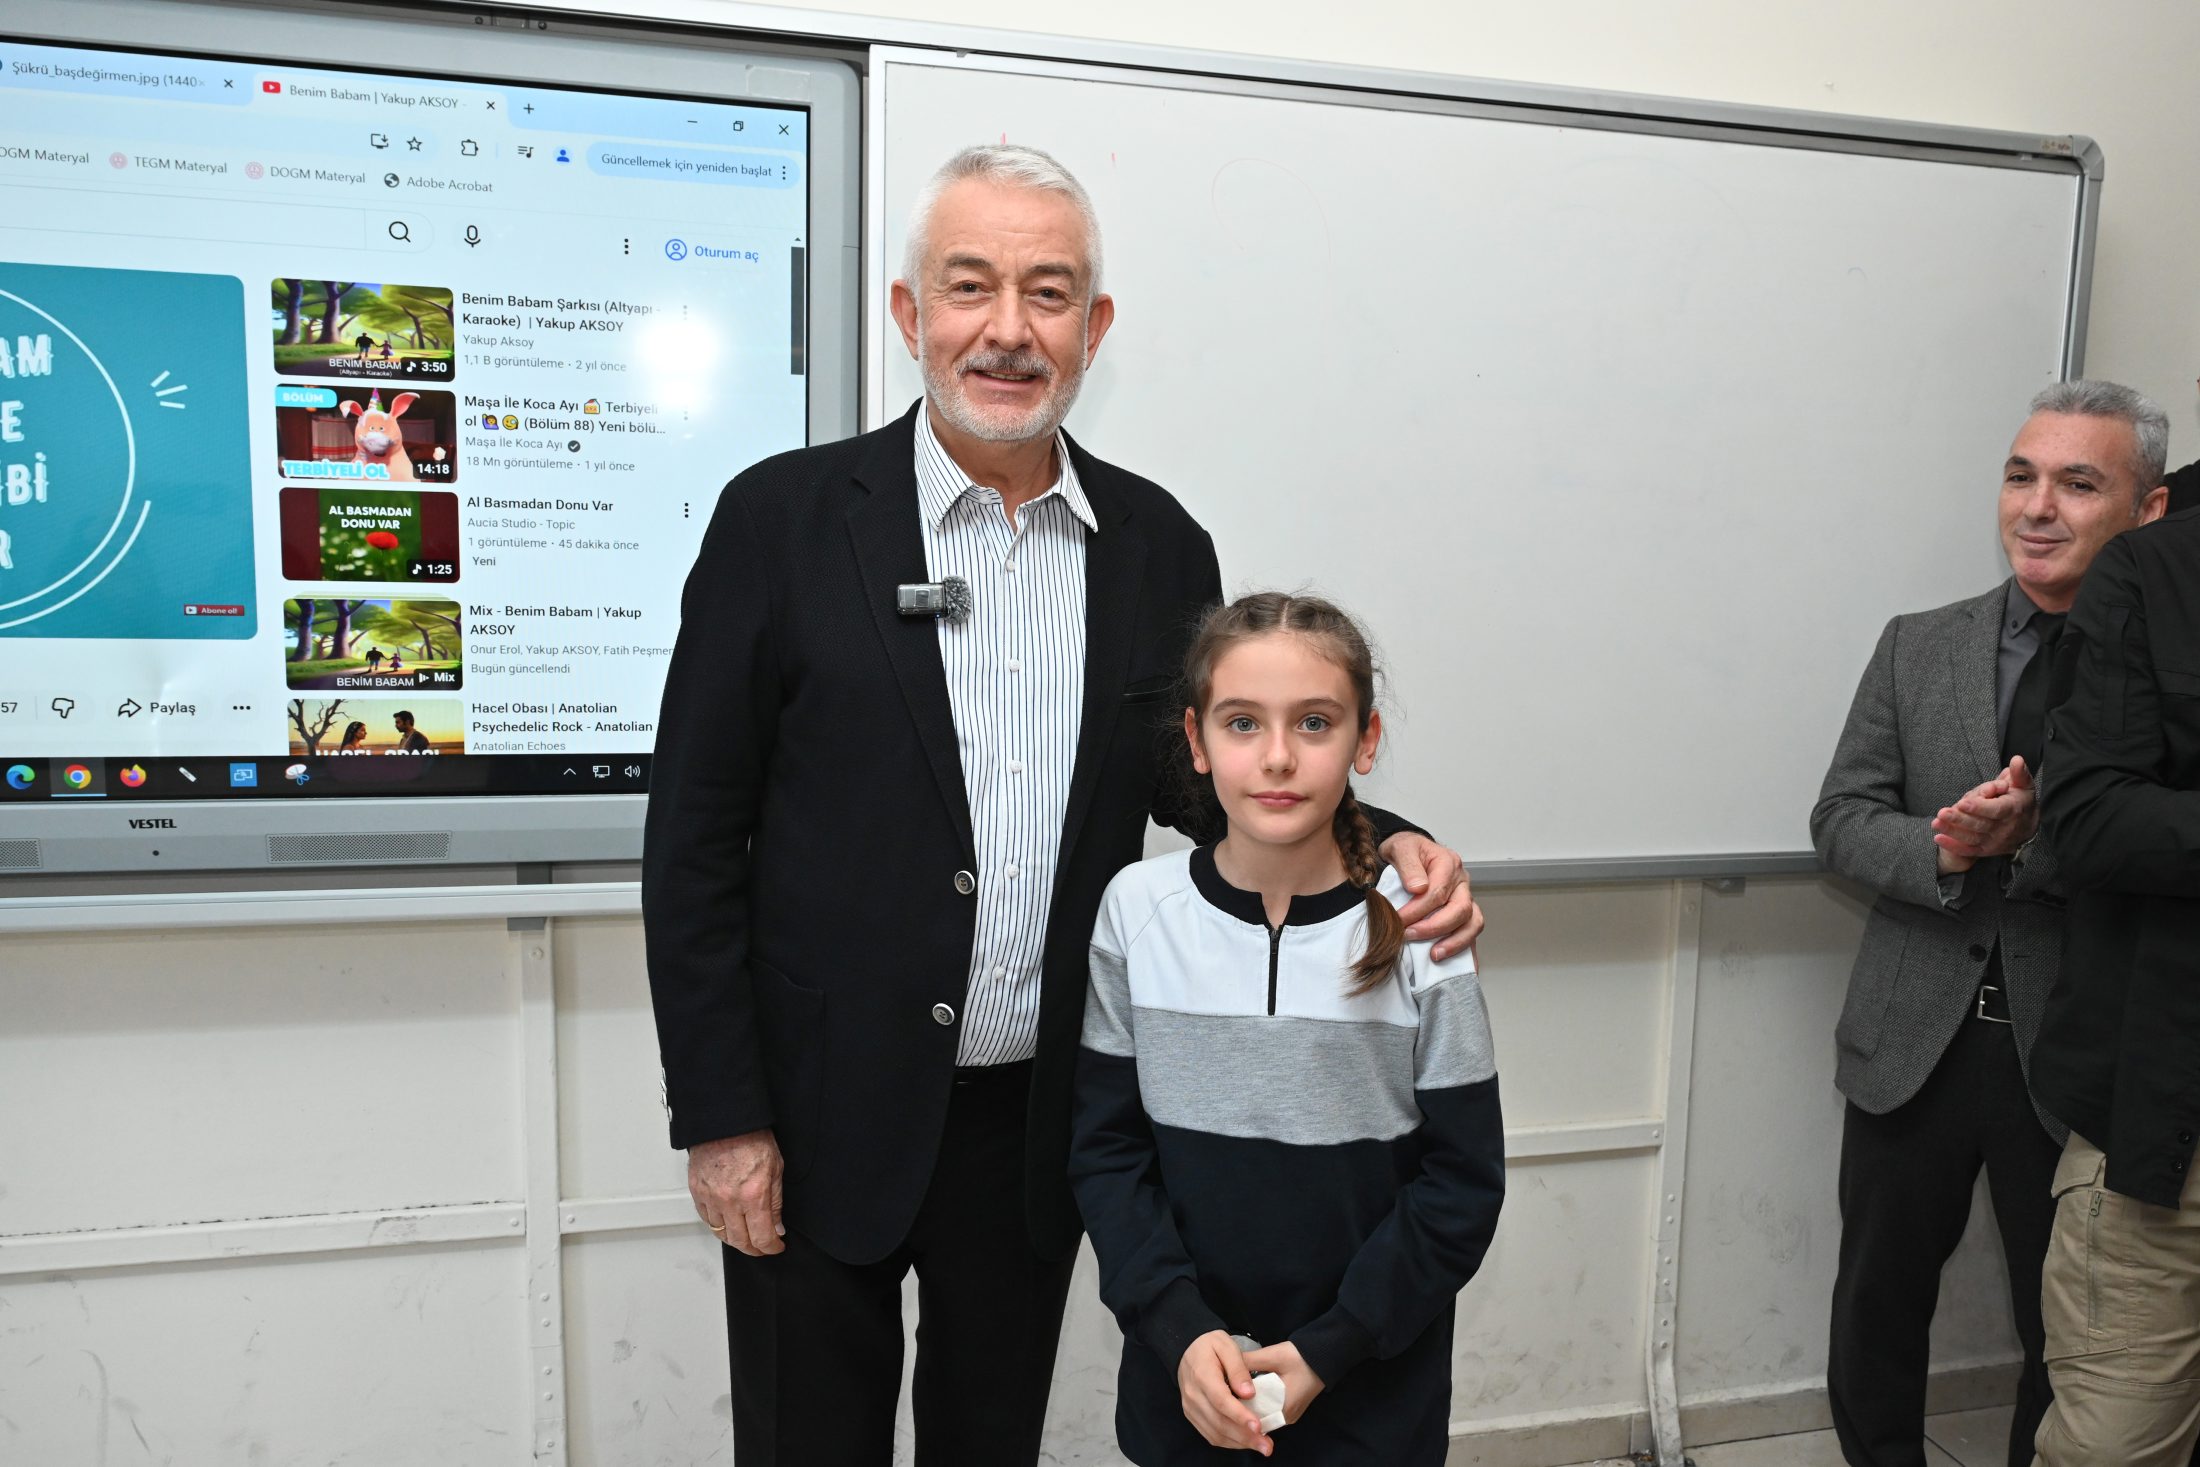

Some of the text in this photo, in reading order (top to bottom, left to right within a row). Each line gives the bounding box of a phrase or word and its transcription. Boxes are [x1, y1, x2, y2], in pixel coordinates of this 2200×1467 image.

[12, 61, 159, 87] Şükrü_başdeğirmen.jpg
[290, 85, 327, 98] Benim
[330, 88, 371, 102] Babam
[381, 93, 415, 107] Yakup
[419, 95, 458, 108] AKSOY
[35, 149, 89, 165] Materyal
[134, 156, 227, 176] TEGM Materyal
[601, 153, 772, 179] Güncellemek için yeniden başlat
[270, 167, 365, 186] DOGM Materyal
[407, 177, 493, 192] Adobe Acrobat
[694, 245, 759, 263] Oturum aç
[462, 293, 503, 306] Benim
[507, 295, 553, 308] Babam
[557, 298, 600, 312] Şarkısı
[604, 300, 653, 316] (Altyapı
[463, 313, 521, 328] Karaoke)
[536, 317, 575, 332] Yakup
[579, 319, 624, 332] AKSOY
[463, 335, 534, 349] Yakup Aksoy
[329, 358, 401, 370] BENİM BABAM
[421, 361, 447, 373] 3:50
[464, 355, 627, 372] 1,1 B görüntüleme 2 yıl önce
[464, 395, 658, 416] Maşa İle Koca Ayı Terbiyeli
[465, 414, 476, 426] ol
[524, 416, 570, 431] (Bölüm
[574, 420, 595, 433] 88)
[599, 421, 625, 433] Yeni
[465, 436, 563, 451] Maşa İle Koca Ayı
[365, 462, 390, 479] OL
[417, 463, 450, 475] 14:18
[466, 457, 635, 473] 18 Mn görüntüleme 1 yıl önce
[0, 452, 49, 506] Bİ
[329, 505, 412, 517] AL BASMADAN
[467, 497, 614, 512] Al Basmadan Donu Var
[341, 518, 400, 530] DONU VAR
[468, 518, 498, 528] Aucia
[502, 519, 537, 529] Studio
[546, 520, 576, 531] Topic
[468, 537, 639, 550] 1 görüntüleme 45 dakika önce
[472, 556, 496, 567] Yeni
[427, 564, 452, 575] 1:25
[469, 605, 493, 616] Mix
[505, 606, 546, 617] Benim
[549, 606, 593, 617] Babam
[603, 607, 642, 620] Yakup
[470, 625, 515, 635] AKSOY
[470, 645, 496, 654] Onur
[500, 645, 523, 656] Erol,
[525, 646, 559, 657] Yakup
[562, 645, 601, 657] AKSOY,
[604, 645, 629, 655] Fatih
[471, 664, 571, 675] Bugün güncellendi
[336, 676, 414, 687] BENİM BABAM
[434, 672, 455, 682] Mix
[150, 702, 196, 716] Paylaş
[472, 703, 508, 713] Hacel
[512, 703, 548, 714] Obası
[558, 703, 617, 714] Anatolian
[472, 722, 548, 735] Psychedelic
[552, 722, 583, 732] Rock
[595, 722, 653, 732] Anatolian
[473, 741, 566, 751] Anatolian Echoes
[128, 818, 177, 829] VESTEL
